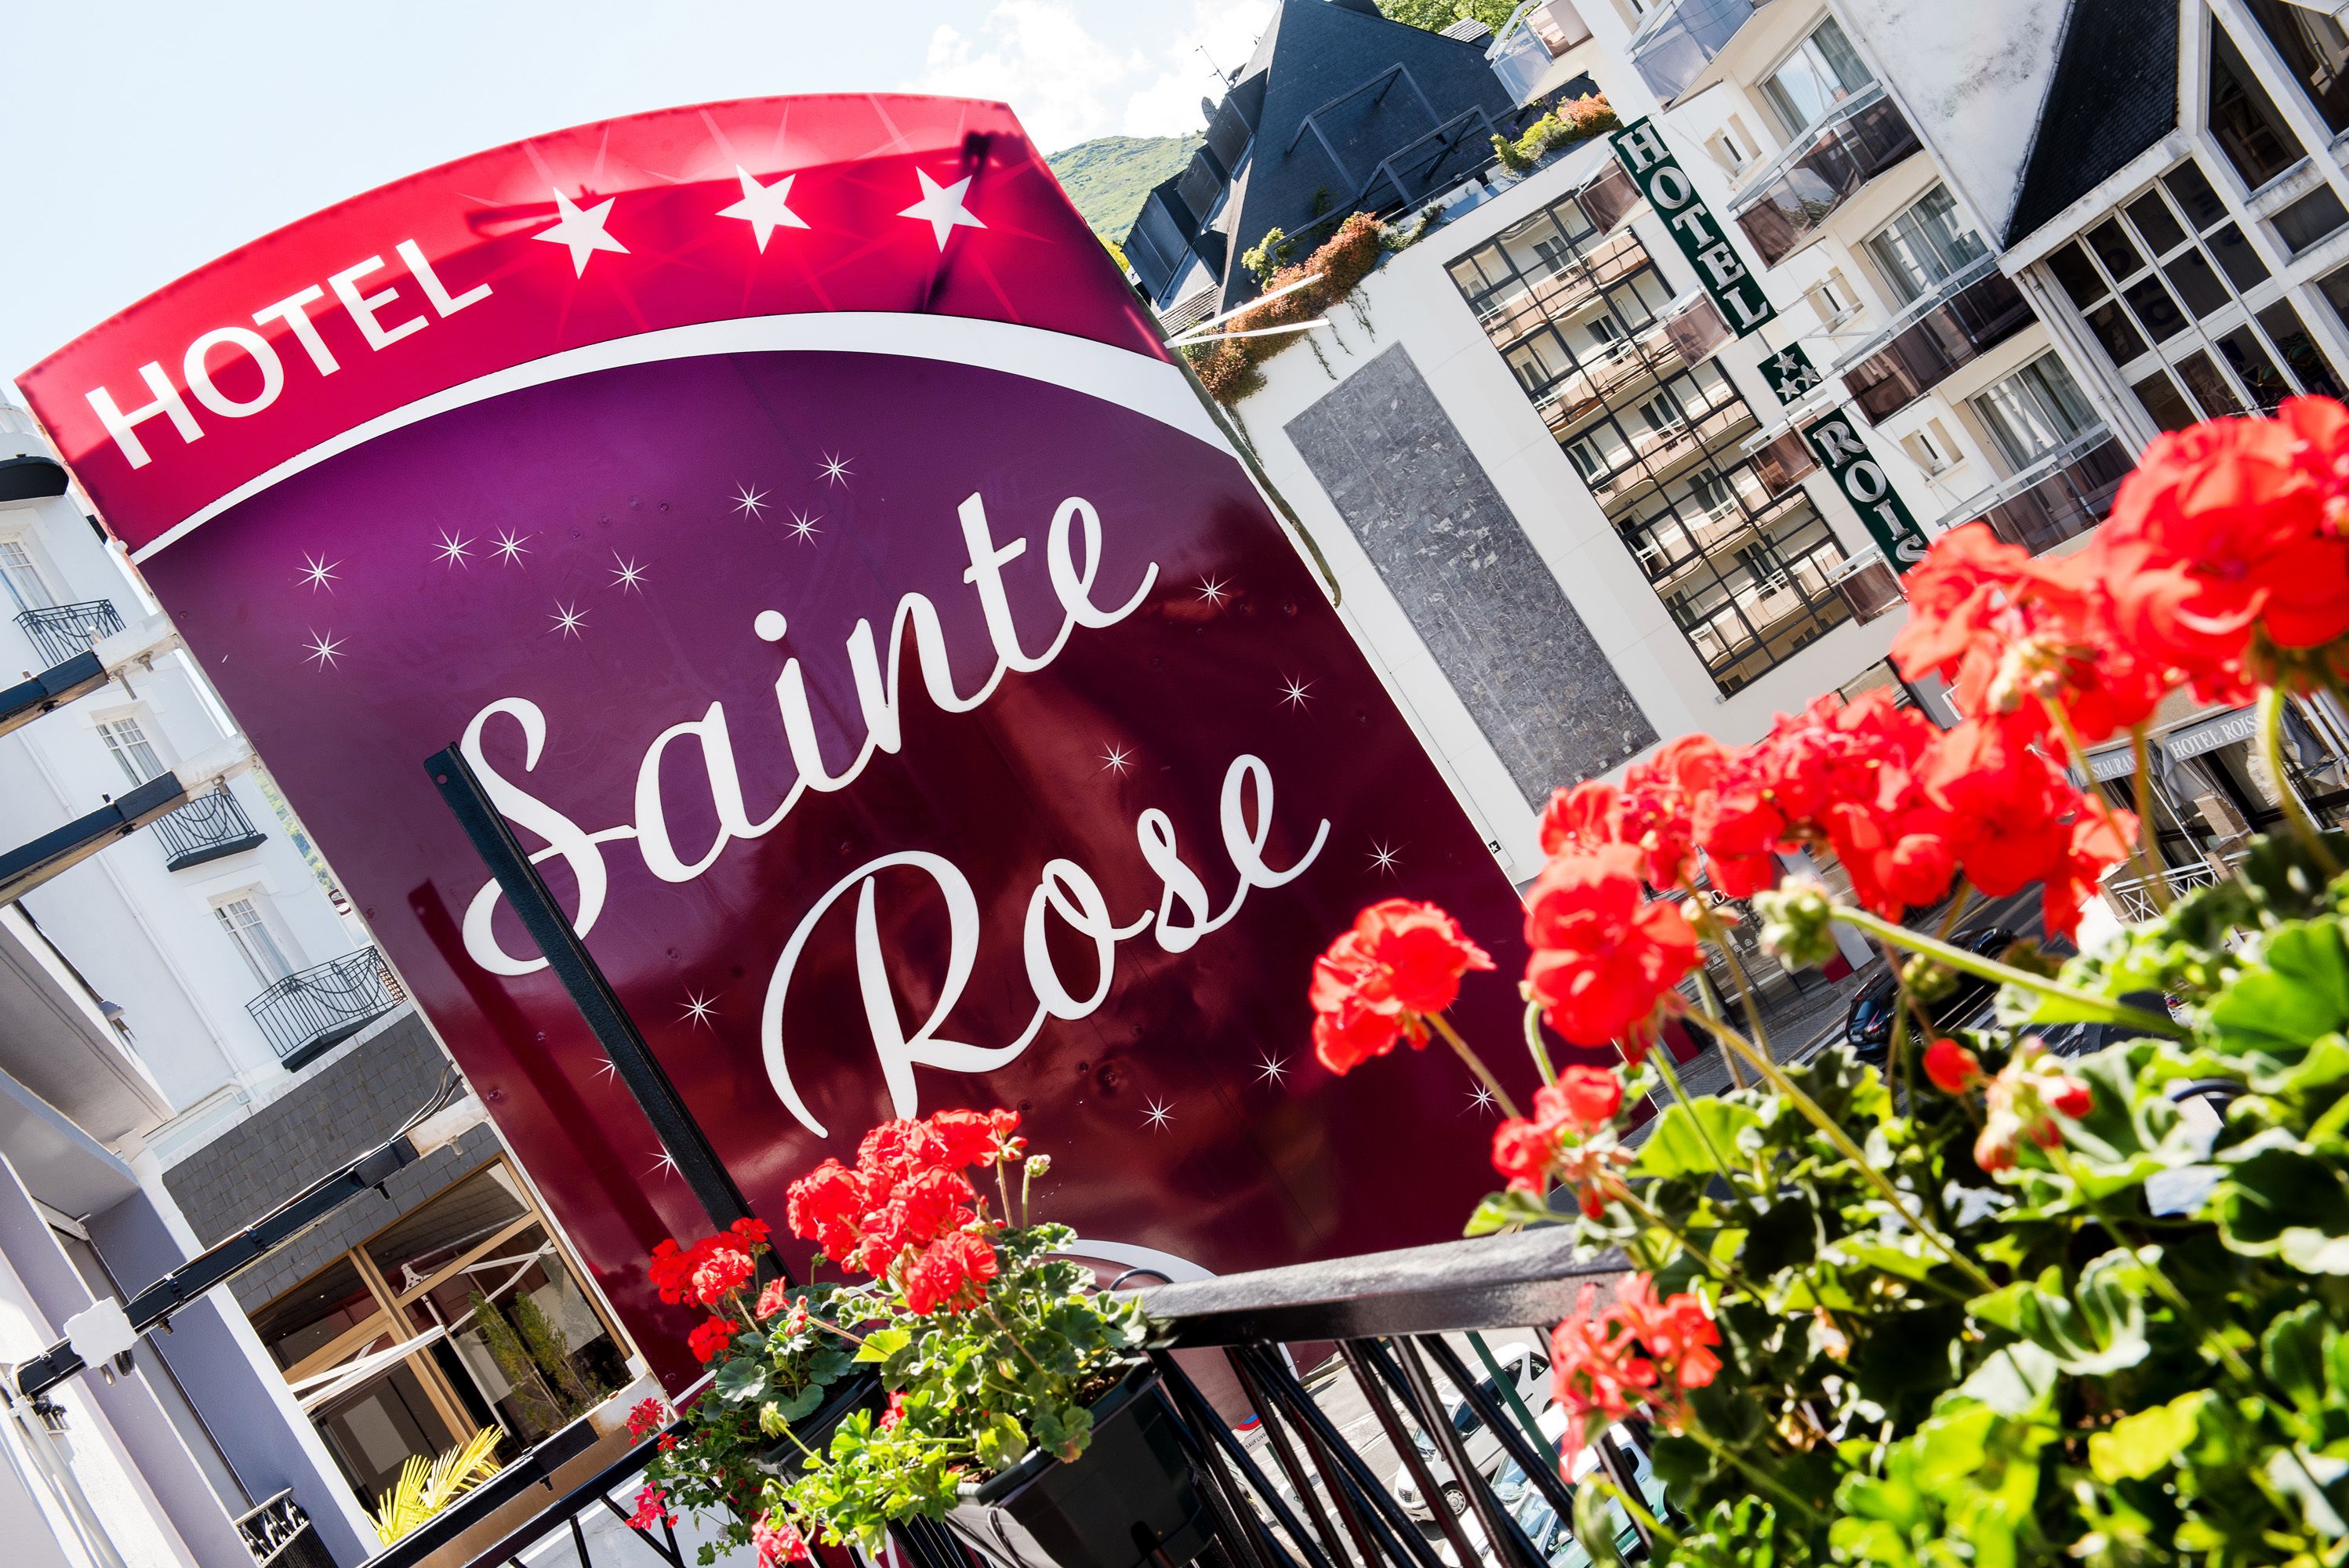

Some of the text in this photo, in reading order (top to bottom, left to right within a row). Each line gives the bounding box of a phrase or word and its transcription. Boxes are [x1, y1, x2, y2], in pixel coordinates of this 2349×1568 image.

[1617, 121, 1769, 329] HOTEL
[85, 239, 492, 469] HOTEL
[460, 492, 1159, 976] Sainte
[2079, 754, 2137, 782] STAURAN
[2169, 730, 2223, 759] HOTEL
[762, 755, 1331, 1138] Rose
